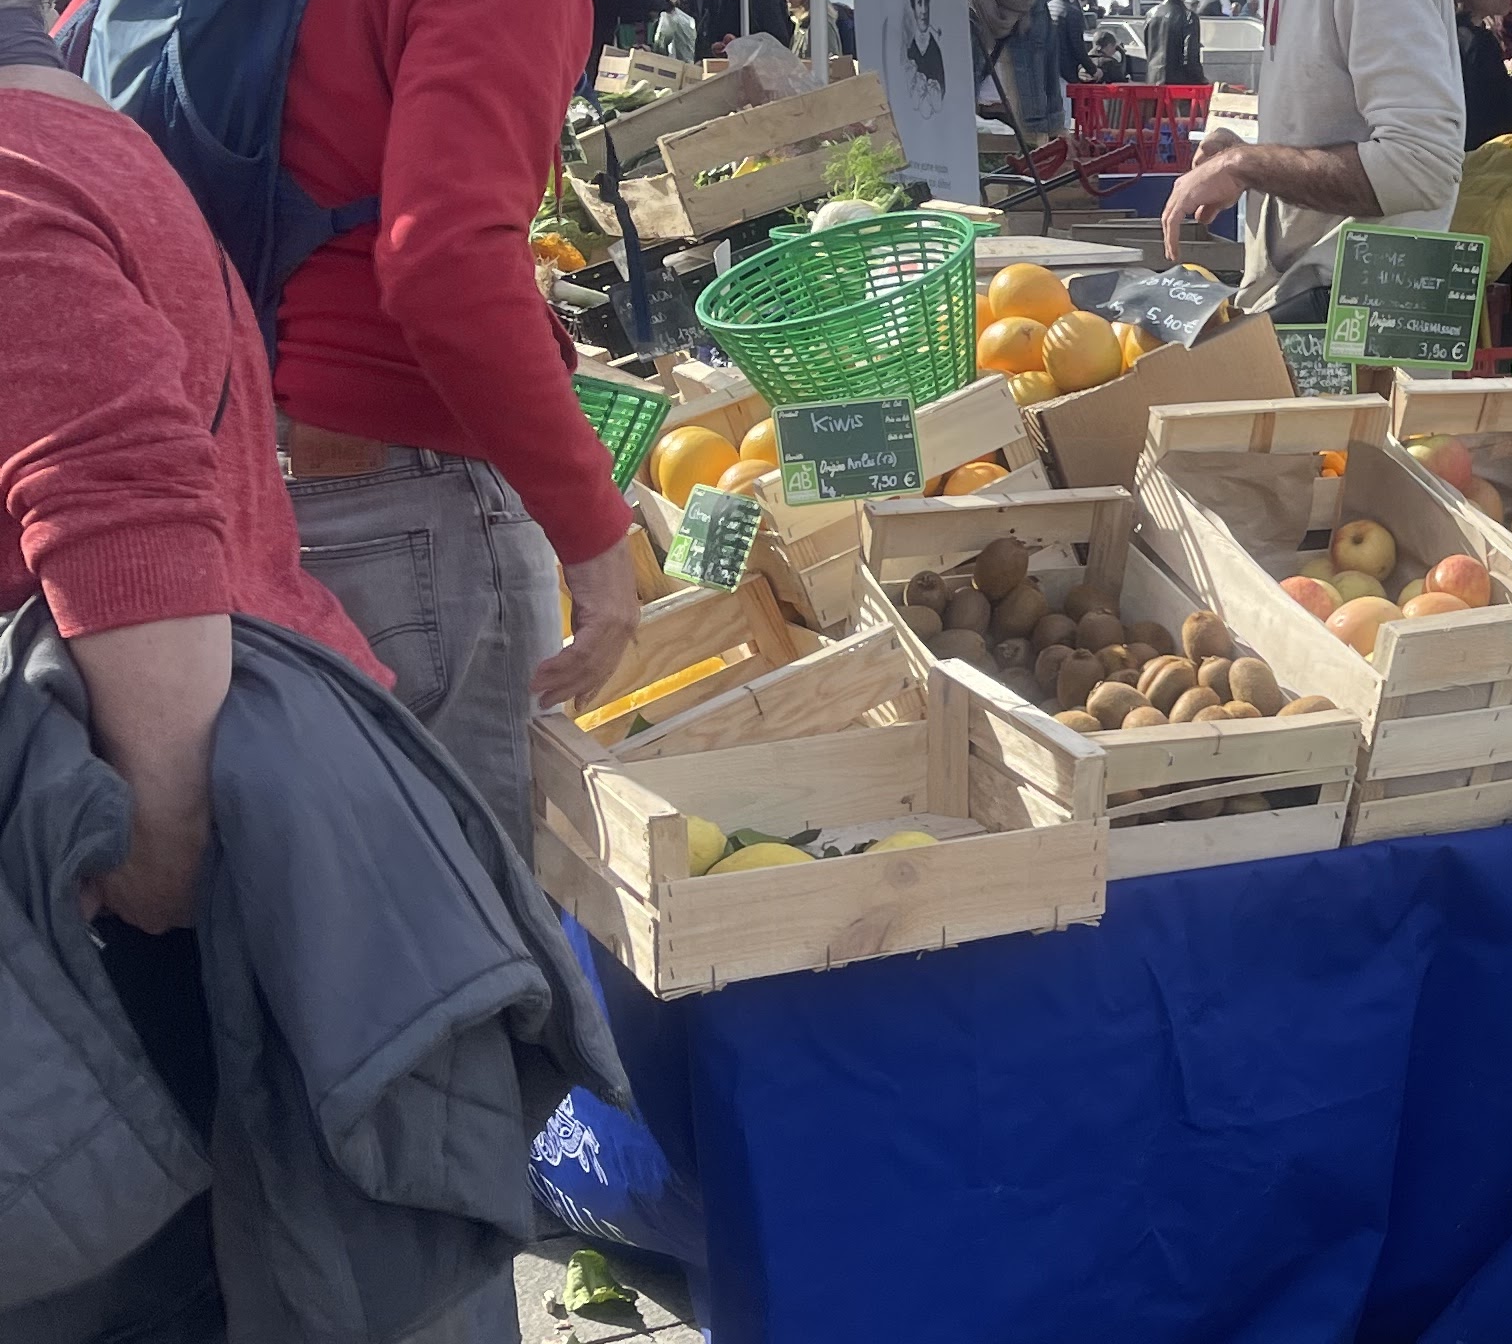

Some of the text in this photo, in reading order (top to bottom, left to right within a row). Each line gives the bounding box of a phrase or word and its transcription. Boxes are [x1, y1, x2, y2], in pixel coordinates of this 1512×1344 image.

[1145, 306, 1181, 331] 5,40
[1183, 319, 1200, 334] €
[1334, 317, 1361, 342] AB
[1418, 341, 1466, 360] 3,90 €
[810, 412, 864, 433] Kiwis
[788, 471, 813, 492] AB
[869, 474, 898, 491] 7,90
[903, 471, 916, 488] €
